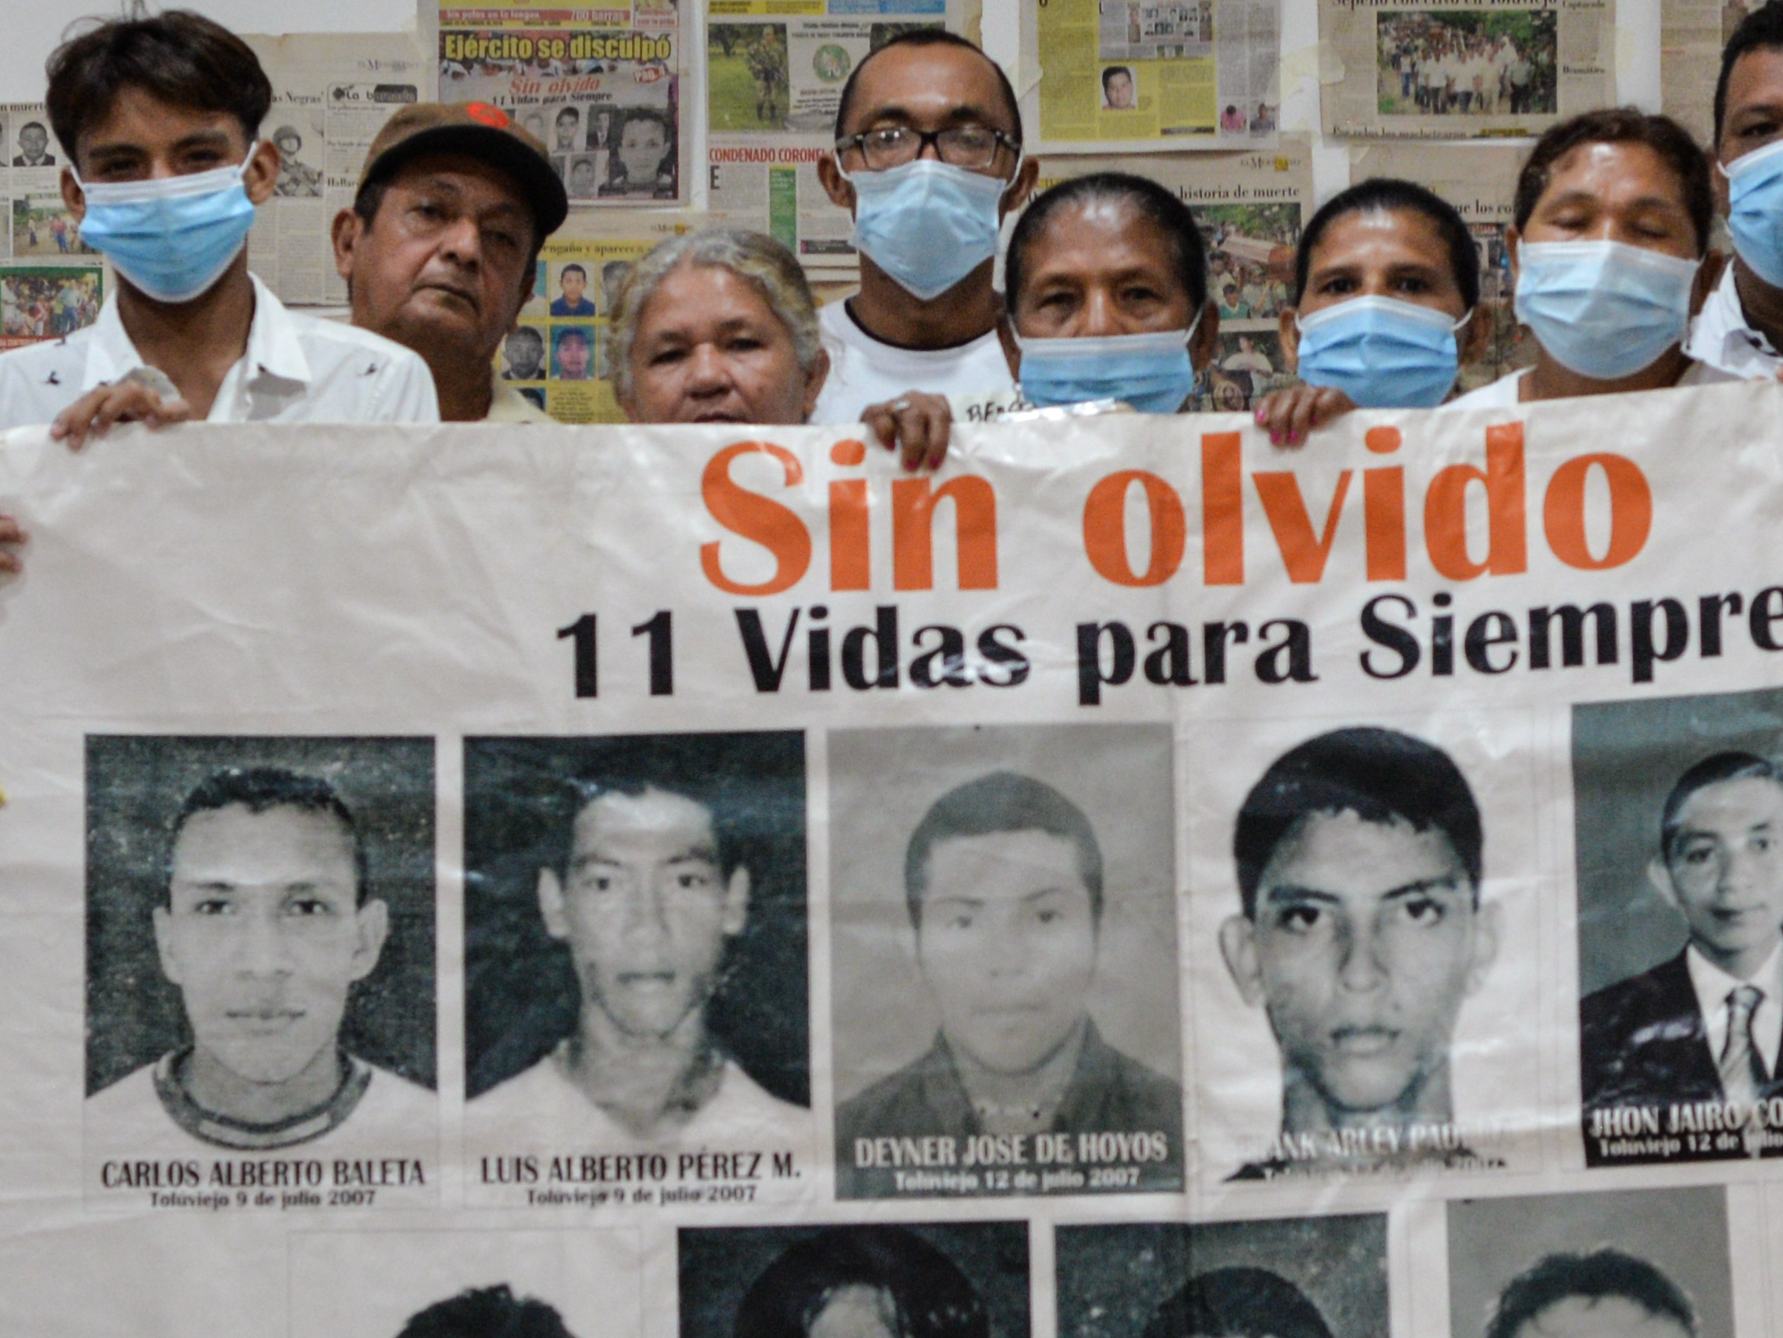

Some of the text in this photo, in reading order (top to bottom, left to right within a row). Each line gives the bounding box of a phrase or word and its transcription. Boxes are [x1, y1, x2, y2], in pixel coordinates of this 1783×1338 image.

[445, 33, 672, 61] Ejército se disculpó
[510, 76, 601, 95] Sin olvido
[9, 101, 48, 112] muert
[510, 95, 540, 105] Vidas
[571, 92, 613, 104] Siempre
[710, 148, 776, 162] CONDENADO
[1180, 185, 1300, 199] historia de muerte
[697, 419, 1655, 599] Sin olvido
[556, 611, 675, 699] 11
[735, 604, 1033, 695] Vidas
[1075, 617, 1320, 708] para
[1589, 1105, 1659, 1138] JHON
[1668, 1100, 1746, 1134] JAIRO
[855, 1130, 1168, 1168] DEYNER JOSE DE HOYOS
[1599, 1137, 1681, 1159] Toluviejo
[1687, 1134, 1711, 1153] 12
[1716, 1132, 1739, 1151] de
[101, 1158, 426, 1189] CARLOS ALBERTO BALETA
[481, 1147, 801, 1184] LUIS ALBERTO PÉREZ M.
[985, 1170, 1009, 1188] 12
[1014, 1169, 1038, 1188] de
[1042, 1168, 1084, 1190] julio
[1089, 1167, 1140, 1187] 2007
[150, 1189, 377, 1211] Toluviejo 9 de julio 2007
[526, 1188, 608, 1209] Toluviejo
[632, 1187, 654, 1203] de
[659, 1186, 702, 1207] julio
[706, 1185, 757, 1202] 2007
